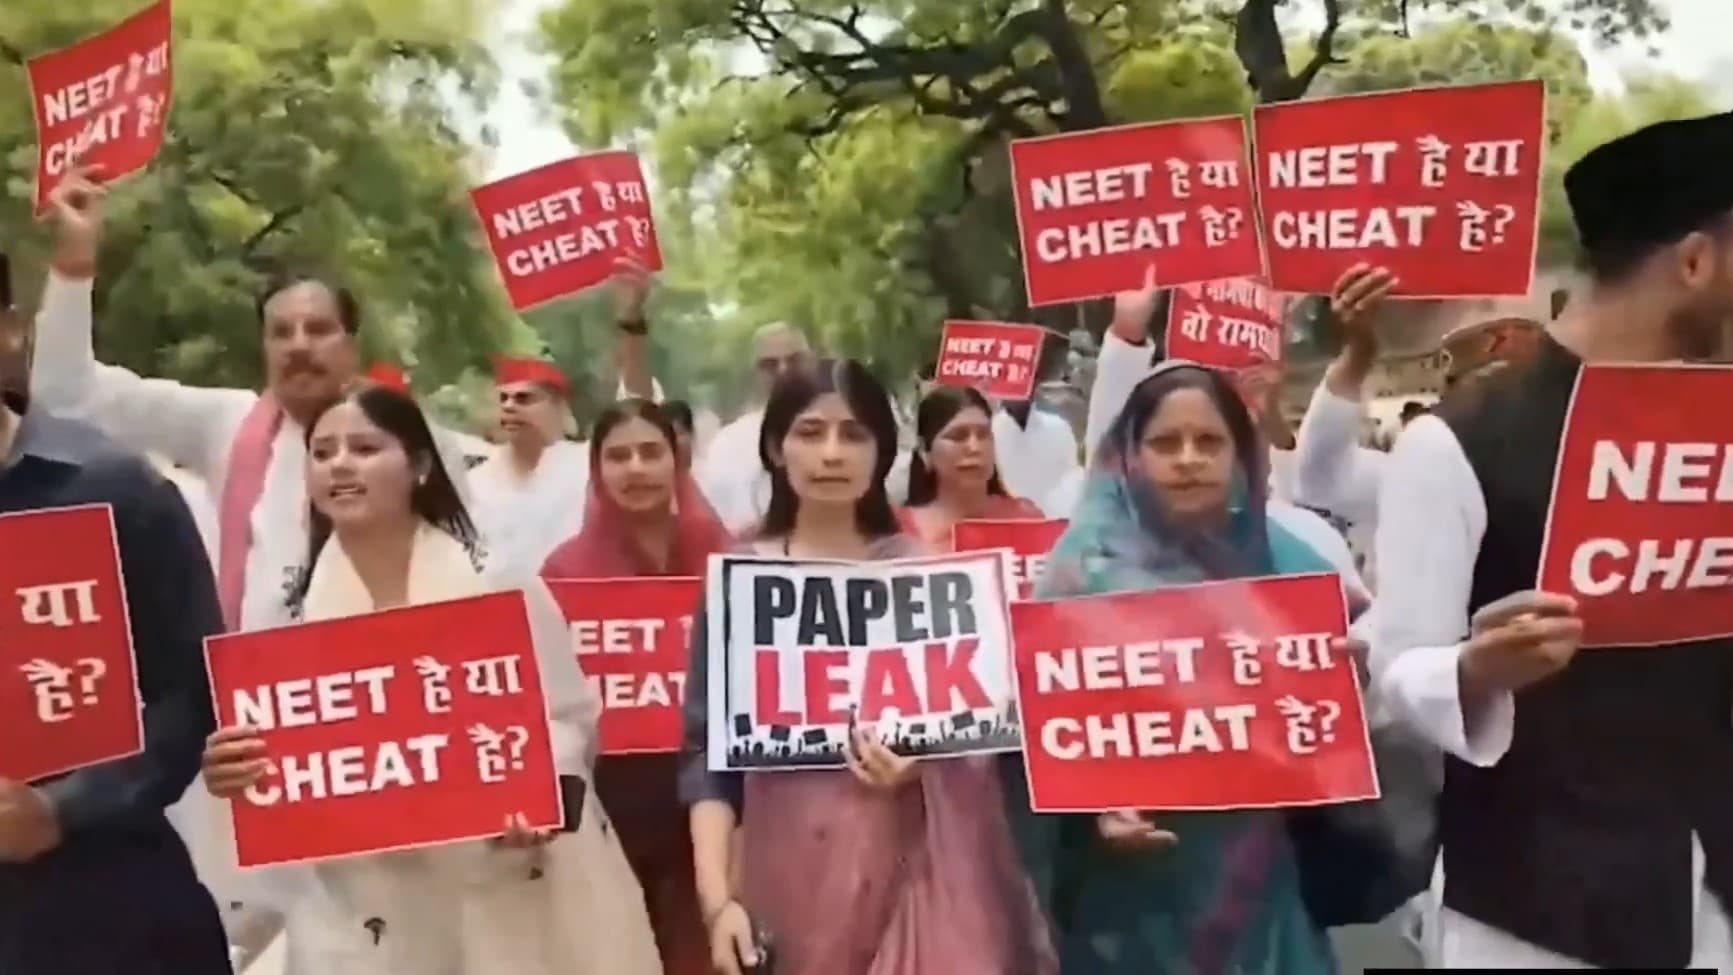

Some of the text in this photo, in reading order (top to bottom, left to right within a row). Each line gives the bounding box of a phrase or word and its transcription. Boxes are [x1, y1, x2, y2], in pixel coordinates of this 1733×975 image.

[43, 63, 123, 127] NEET
[1030, 157, 1239, 211] NEET है या
[1269, 134, 1524, 188] NEET है या
[493, 181, 643, 239] NEET है या
[1037, 205, 1243, 262] CHEAT है?
[1273, 200, 1515, 252] CHEAT है?
[508, 219, 619, 276] CHEAT
[942, 360, 1003, 377] CHEAT
[15, 579, 102, 627] या
[754, 571, 977, 646] PAPER
[18, 657, 107, 722] है?
[755, 638, 993, 726] LEAK
[1034, 630, 1335, 693] NEET है या
[232, 654, 523, 731] NEET है या
[1041, 694, 1341, 760] CHEAT है?
[245, 722, 529, 806] CHEAT है?
